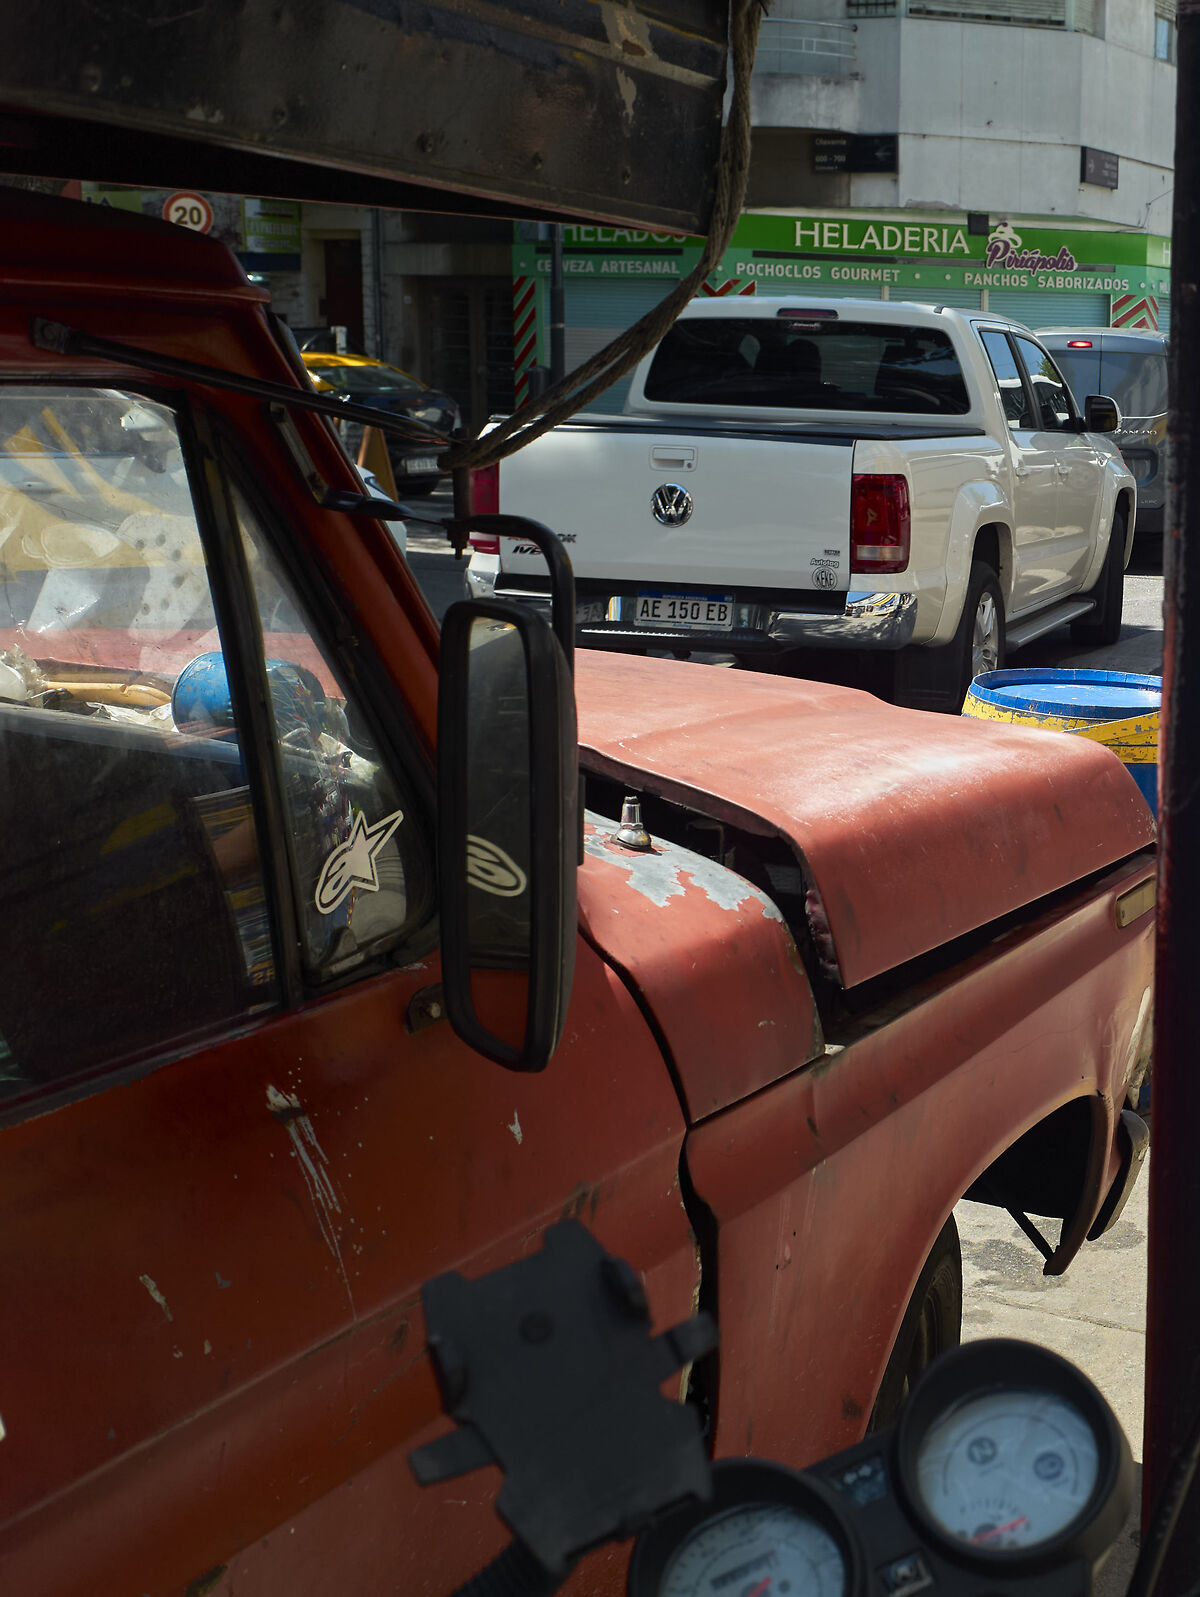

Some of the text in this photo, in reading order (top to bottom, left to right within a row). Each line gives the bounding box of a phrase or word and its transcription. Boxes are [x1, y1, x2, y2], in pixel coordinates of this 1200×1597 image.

[174, 206, 202, 225] 20
[794, 221, 970, 254] HELADERIA
[536, 260, 680, 274] CEVEZA ARTESANAL
[987, 239, 1077, 275] Piriápolis
[736, 262, 900, 282] POCHOCLOS GOURMET
[964, 272, 1129, 291] PANCHOS SABORIZADOS
[640, 599, 728, 622] AE 150 EB
